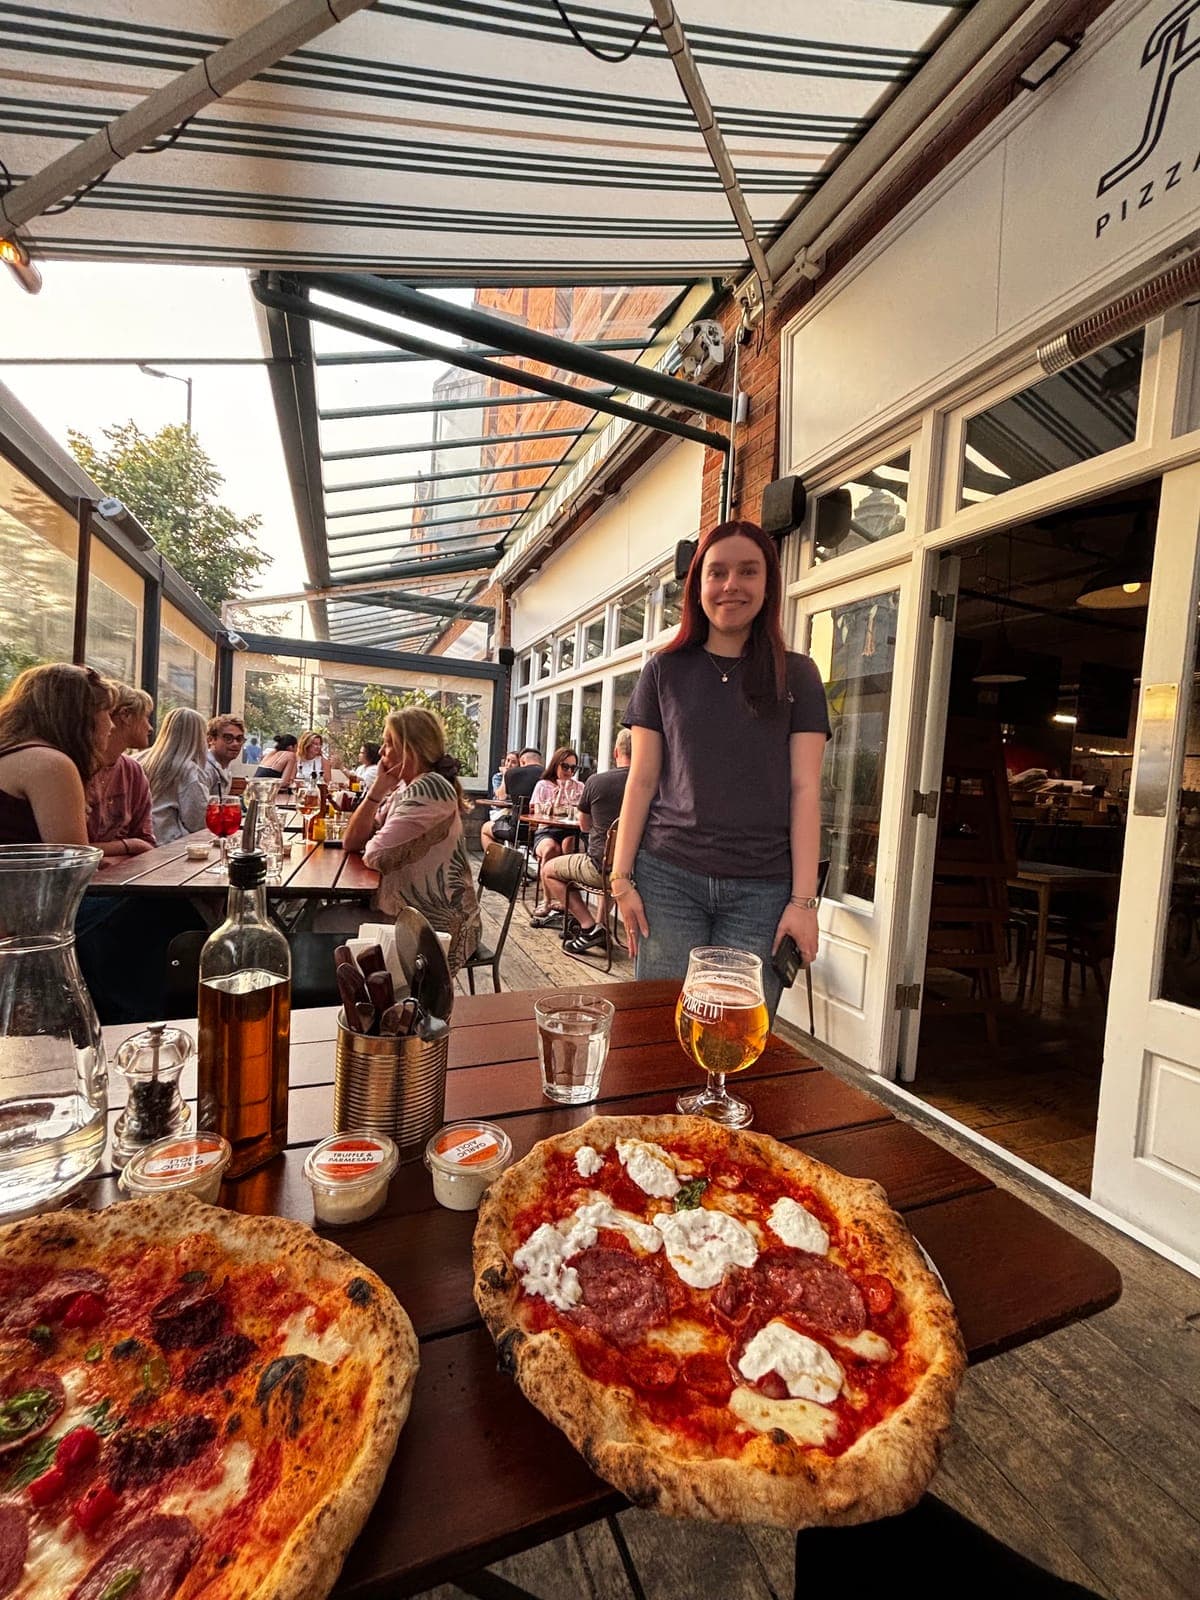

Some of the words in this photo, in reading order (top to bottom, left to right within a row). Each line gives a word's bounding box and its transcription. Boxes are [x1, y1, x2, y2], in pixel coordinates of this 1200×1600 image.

[455, 1140, 477, 1152] AIOLI
[456, 1142, 486, 1158] GARLIC
[160, 1159, 204, 1171] GARLIC
